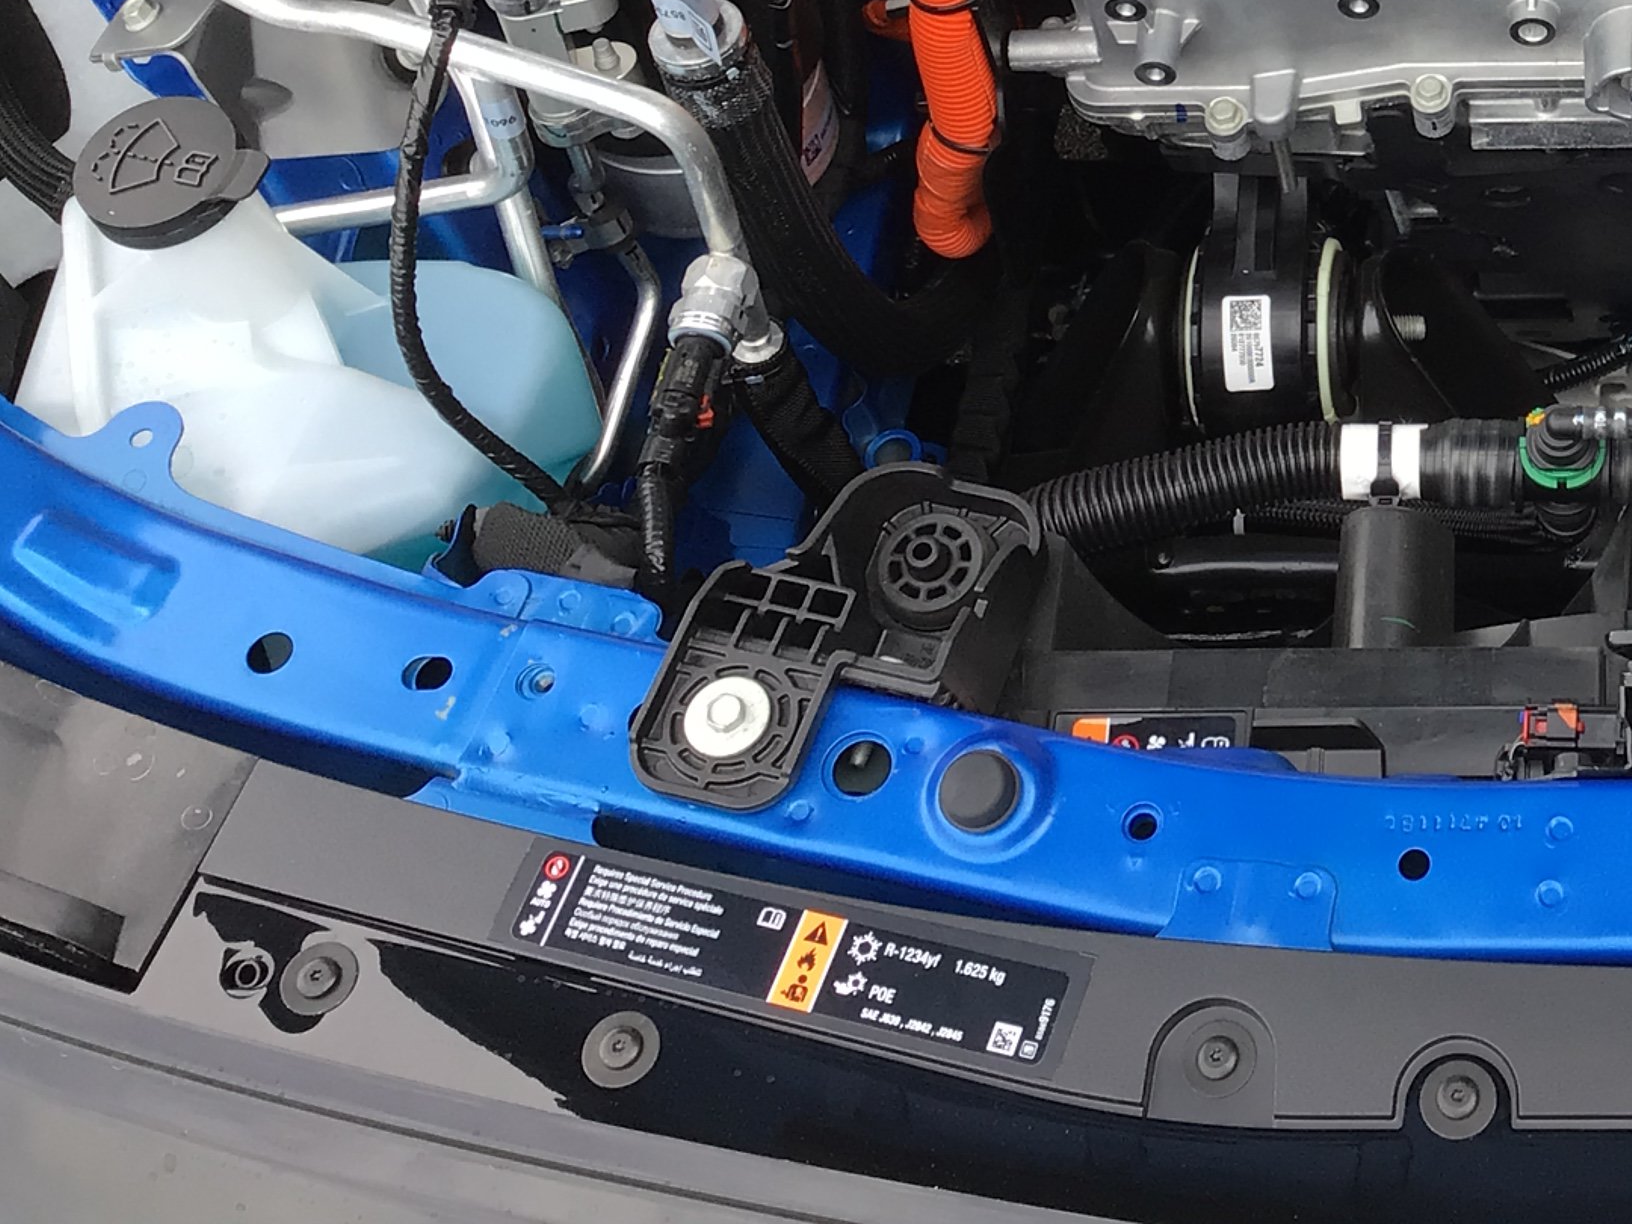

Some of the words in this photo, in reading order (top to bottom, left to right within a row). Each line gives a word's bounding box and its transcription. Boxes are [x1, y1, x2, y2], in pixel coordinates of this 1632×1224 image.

[593, 864, 624, 879] Requires
[624, 871, 651, 885] Special
[650, 878, 677, 892] Service
[676, 884, 712, 901] Procedure
[529, 896, 551, 908] AUTO
[657, 892, 668, 901] de
[667, 895, 693, 907] service
[653, 916, 664, 925] de
[663, 917, 691, 931] Servicio
[690, 923, 720, 938] Especial
[668, 943, 699, 956] especial
[884, 942, 941, 968] R-1234yf
[955, 959, 988, 978] 1.625
[988, 967, 1005, 985] kg
[868, 984, 895, 1003] POE
